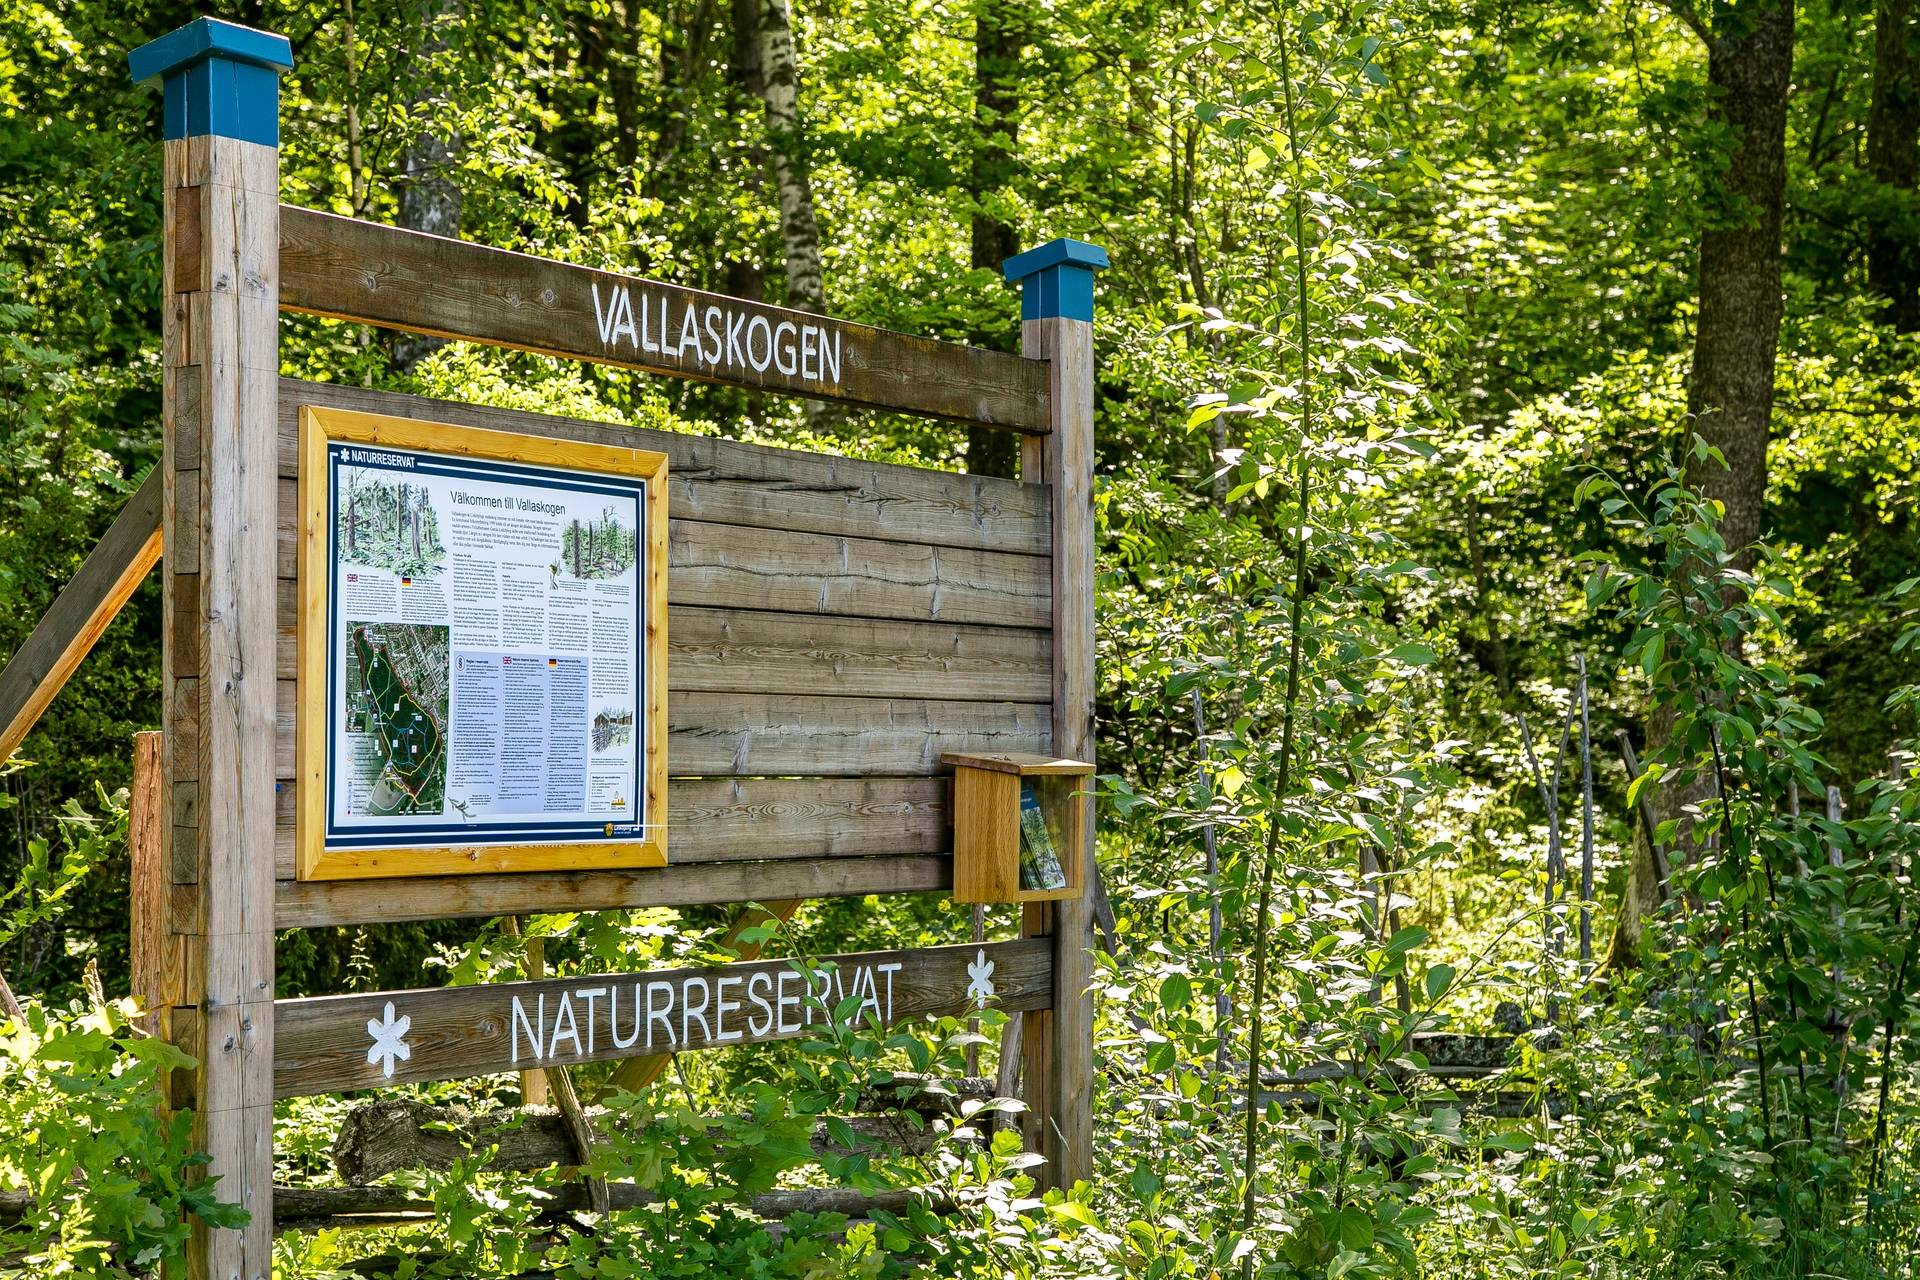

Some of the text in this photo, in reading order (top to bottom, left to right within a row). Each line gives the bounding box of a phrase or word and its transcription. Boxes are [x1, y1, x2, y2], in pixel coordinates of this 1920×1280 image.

[591, 283, 841, 384] VALLASKOGEN
[351, 449, 415, 468] NATURRESERVAT
[450, 490, 566, 517] Välkommen till Vallaskogen
[511, 963, 903, 1062] NATURRESERVAT
